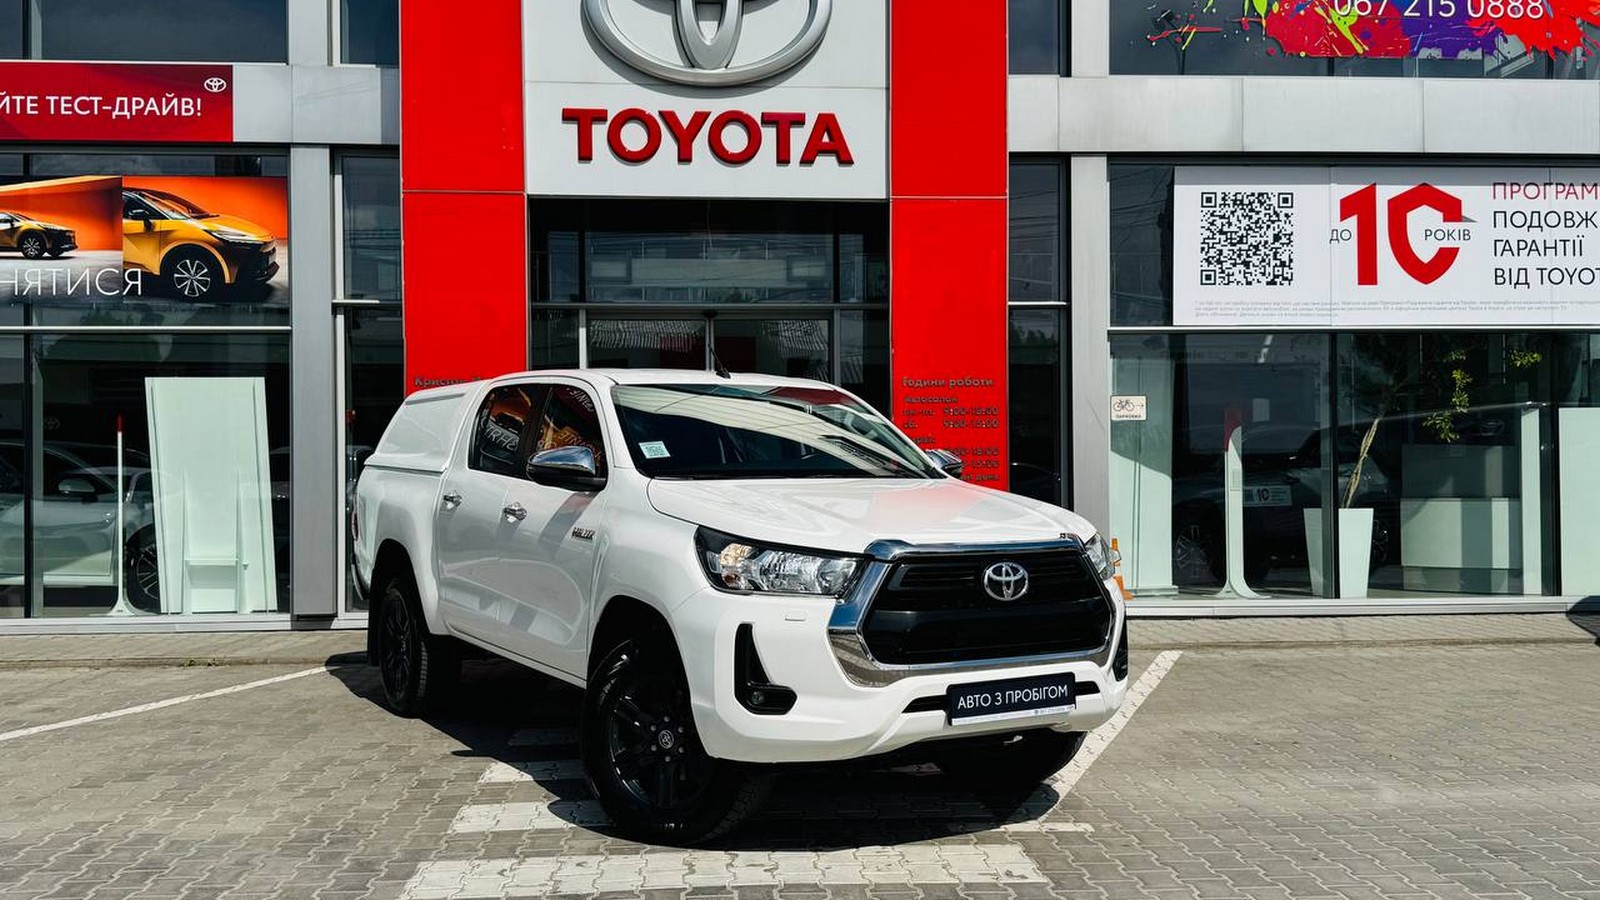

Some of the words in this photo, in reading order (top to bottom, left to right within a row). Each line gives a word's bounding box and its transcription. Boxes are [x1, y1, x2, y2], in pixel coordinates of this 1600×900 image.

[1334, 0, 1389, 16] 067
[1403, 0, 1456, 17] 215
[1467, 0, 1544, 18] 0888
[0, 91, 38, 114] ЙТЕ
[45, 92, 201, 120] ТЕСТ-ДРАЙВ!
[562, 107, 855, 167] TOYOTA
[1492, 182, 1598, 200] ПРОГРАМ
[1493, 210, 1598, 233] ПОДОВЖ
[1329, 228, 1352, 244] ДО
[1424, 228, 1472, 241] РОКІВ
[1493, 234, 1585, 257] ГАРАНТІЇ
[1494, 267, 1530, 289] ВІД
[902, 376, 944, 388] Години
[949, 376, 994, 390] роботи
[957, 693, 992, 710] АВТО
[1005, 684, 1068, 704] ПРОБІГОМ
